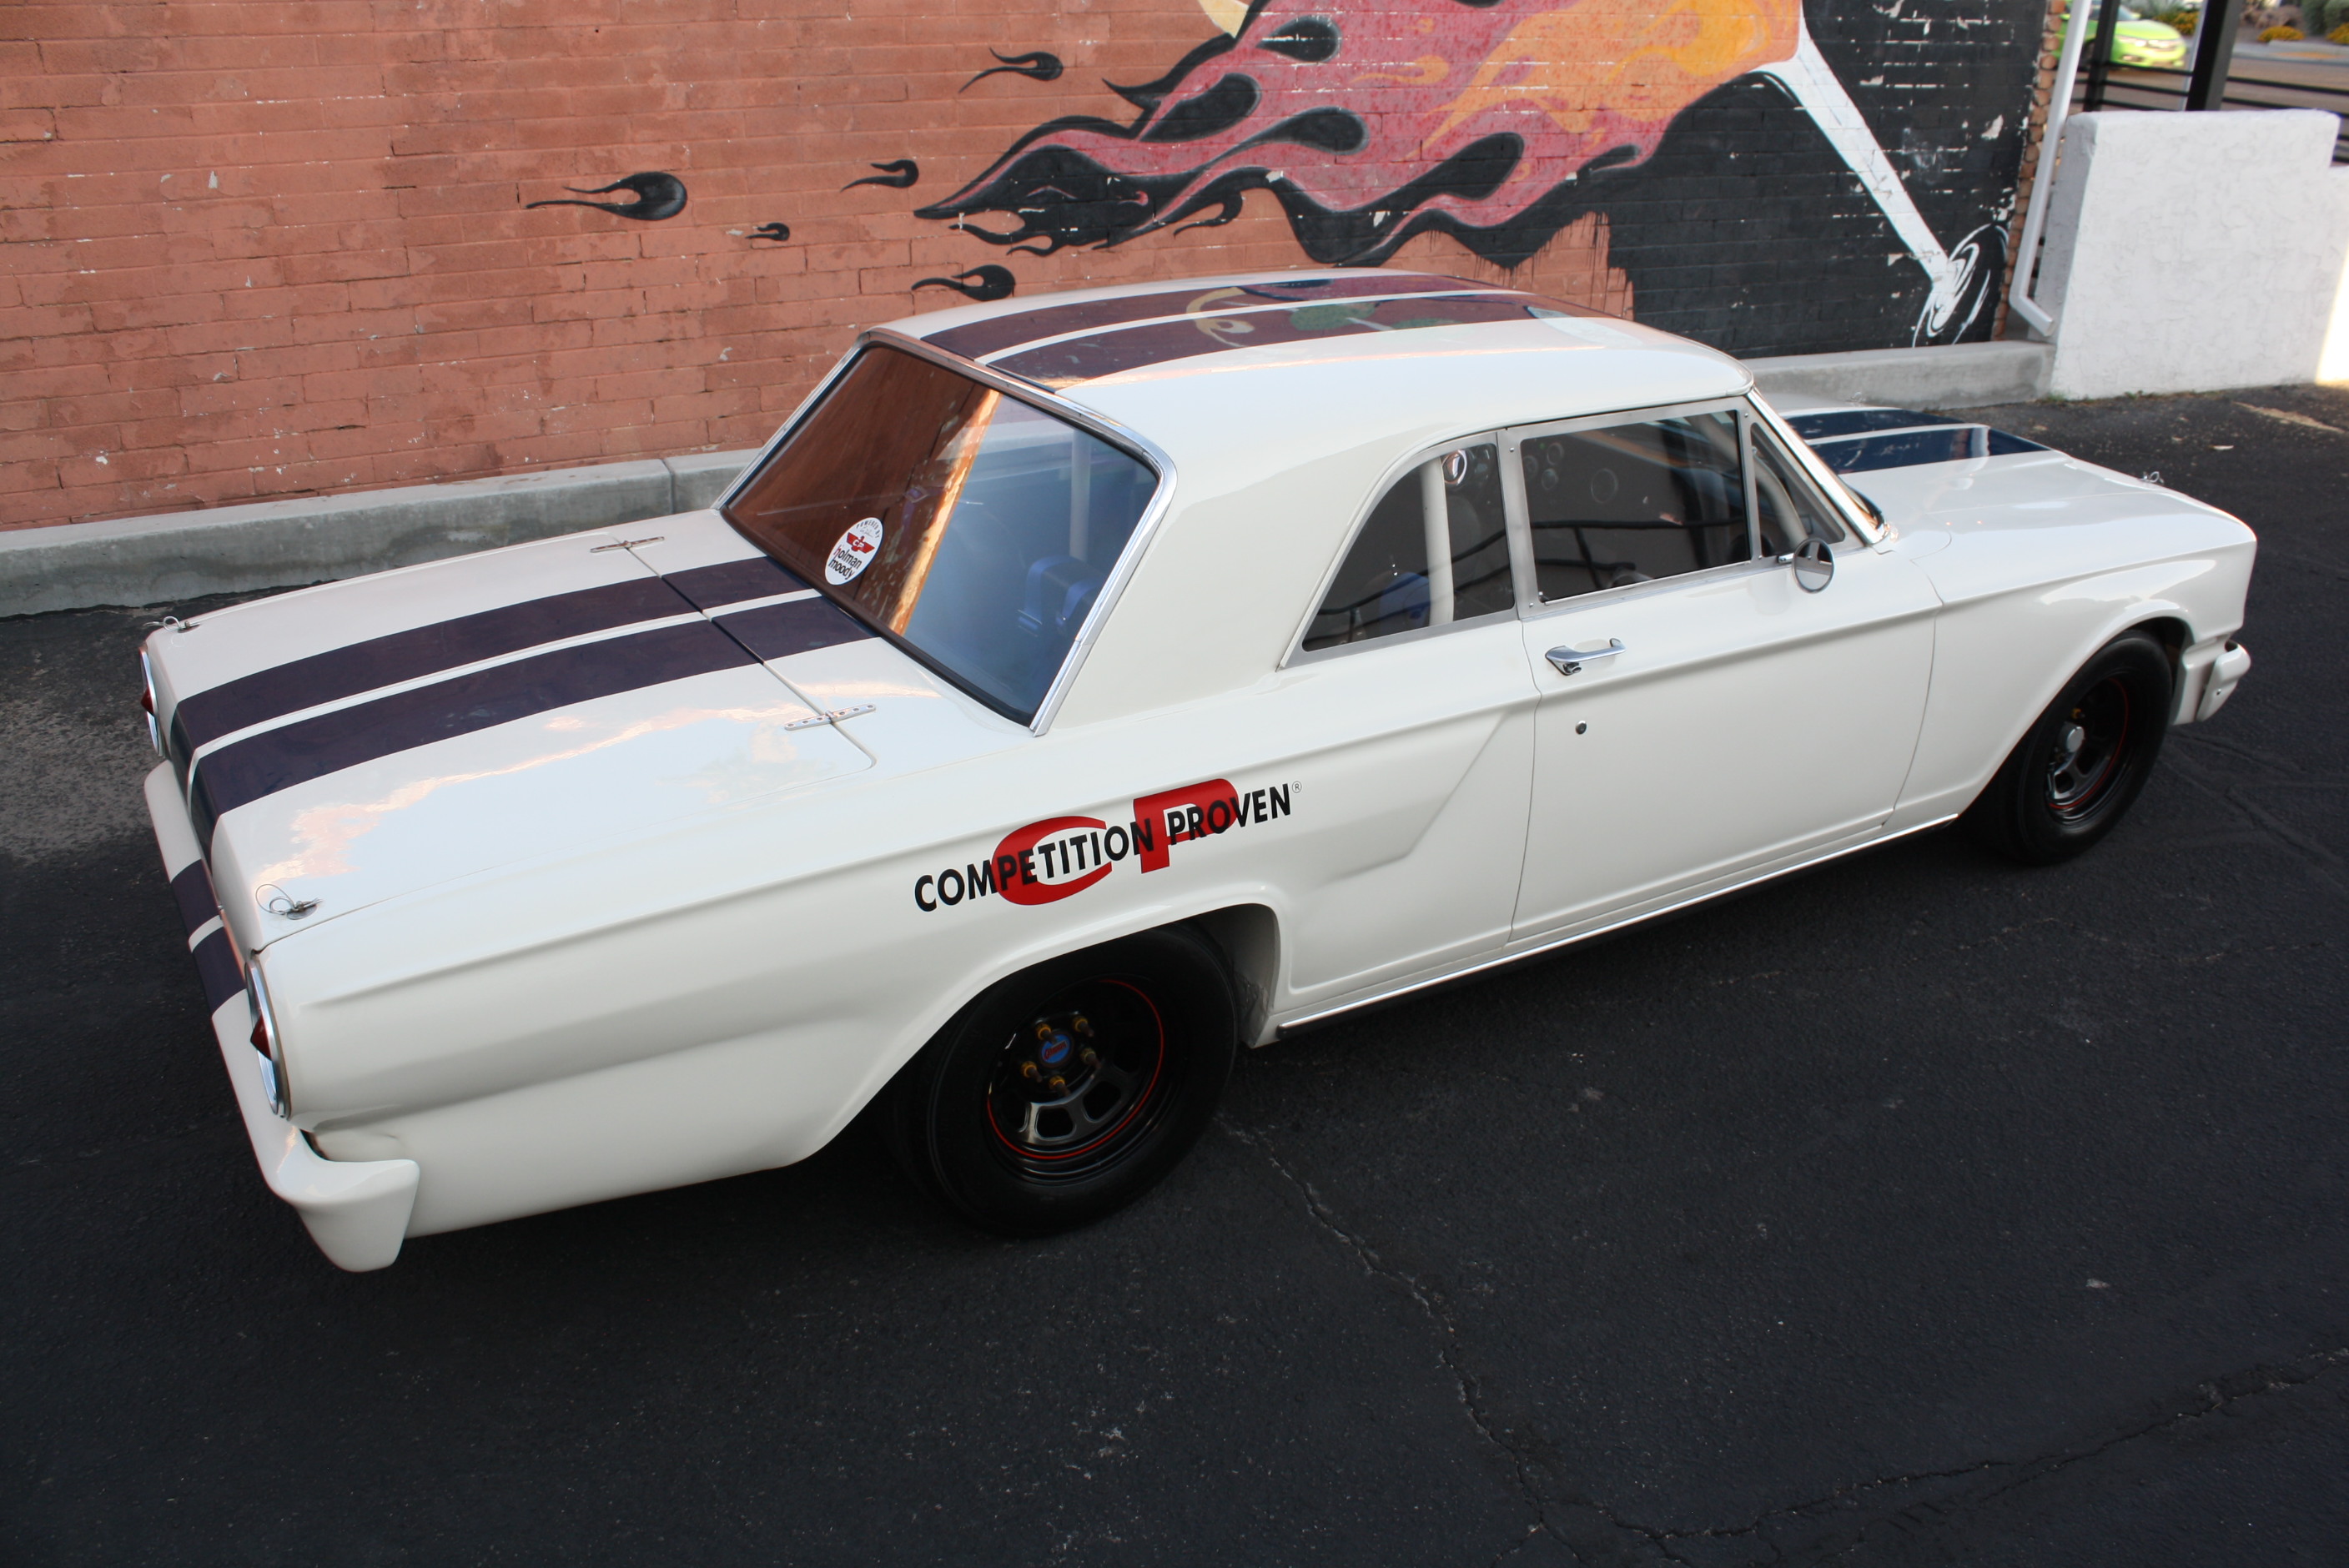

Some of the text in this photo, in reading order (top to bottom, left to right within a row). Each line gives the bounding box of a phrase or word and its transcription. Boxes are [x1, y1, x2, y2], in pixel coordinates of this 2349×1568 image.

[828, 559, 855, 580] moody
[833, 545, 863, 570] holman
[914, 817, 1154, 912] COMPETITION
